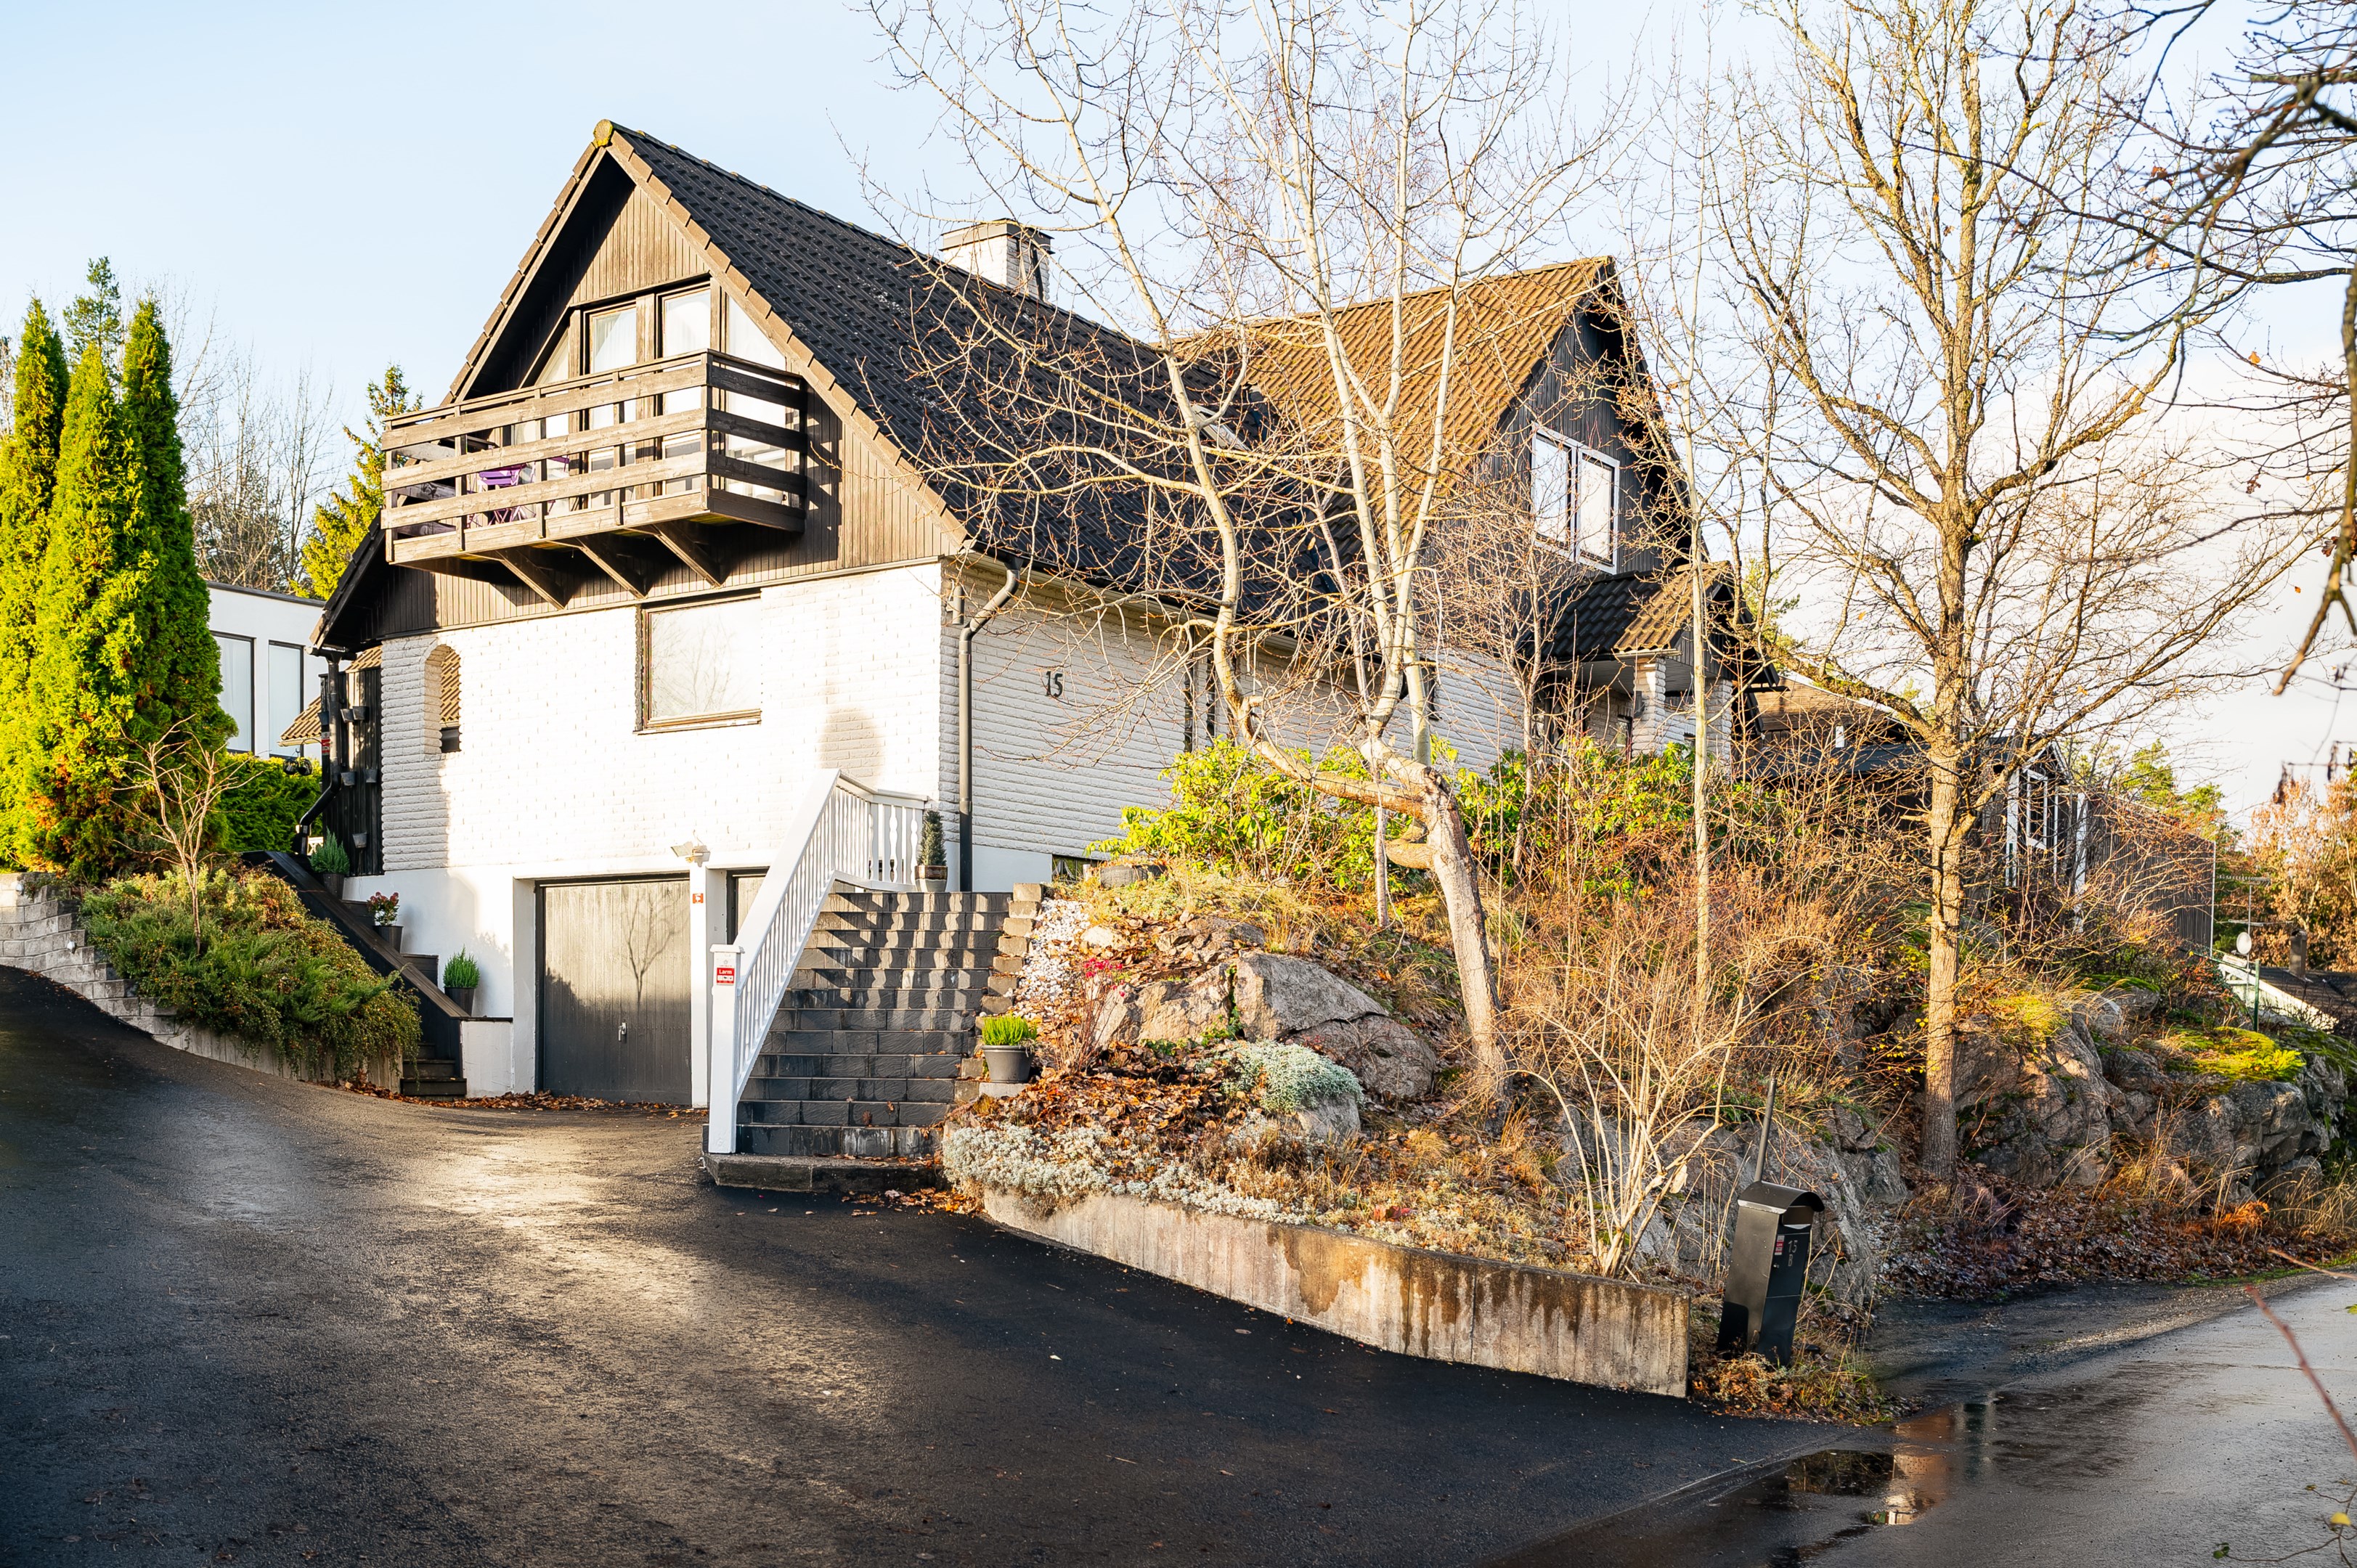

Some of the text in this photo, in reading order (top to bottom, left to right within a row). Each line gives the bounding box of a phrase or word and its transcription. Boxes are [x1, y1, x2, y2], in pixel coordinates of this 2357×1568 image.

[1046, 671, 1063, 698] 15
[1788, 1240, 1798, 1253] 15
[1788, 1254, 1794, 1267] B
